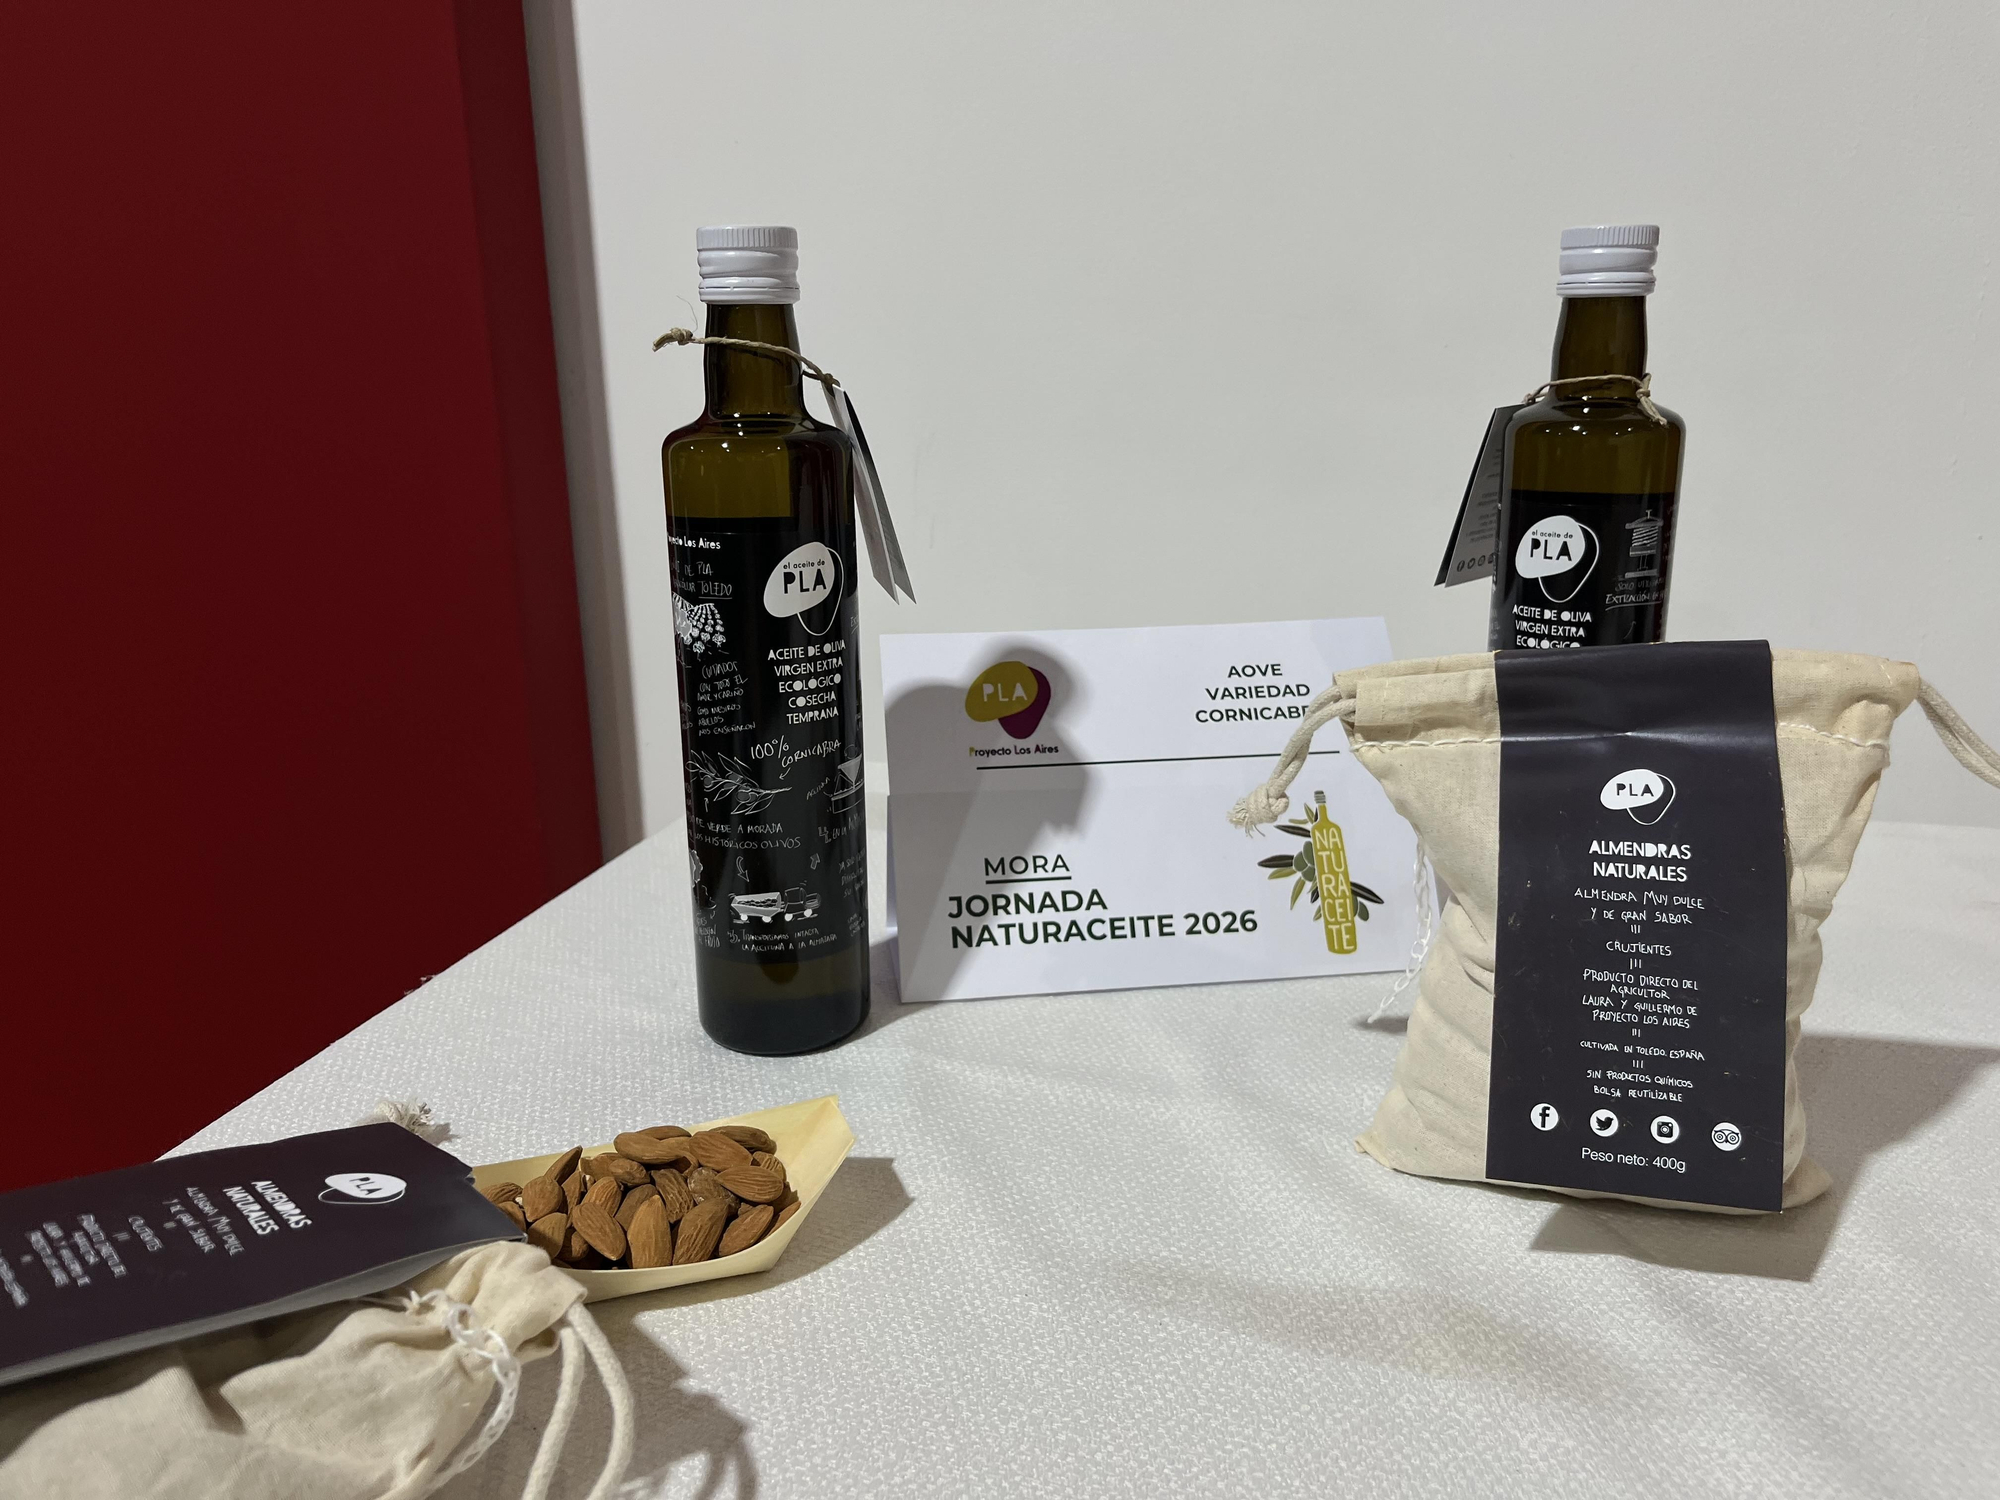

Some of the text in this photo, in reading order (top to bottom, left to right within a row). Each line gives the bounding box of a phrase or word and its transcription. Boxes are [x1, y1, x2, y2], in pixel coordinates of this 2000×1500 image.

[684, 536, 697, 548] Los
[698, 537, 721, 550] Aires
[1539, 530, 1561, 538] aceite
[1530, 538, 1572, 562] PLA
[696, 560, 714, 576] PLA
[783, 558, 826, 570] el aceite de
[697, 580, 733, 596] TOLEDO
[783, 568, 827, 594] PLA
[1512, 604, 1592, 622] ACEITE DE OLIVA
[1516, 620, 1586, 638] VIRGEN EXTRA
[768, 639, 846, 660] ACEITE DE OLIVA
[774, 656, 844, 676] VIRGEN EXTRA
[1228, 664, 1283, 678] AOVE
[779, 673, 842, 692] ECOLÓGICO
[982, 682, 1028, 702] PLA
[1205, 684, 1310, 700] VARIEDAD
[788, 690, 836, 708] COSECHA
[786, 706, 839, 724] TEMPRANA
[1195, 705, 1310, 723] CORNICAB
[750, 734, 790, 760] 100%
[782, 739, 842, 768] CORNICABRA
[969, 744, 1060, 758] Proyecto Los Aires
[1616, 782, 1654, 797] PLA
[747, 822, 784, 834] MORADA
[760, 836, 802, 850] OLIVOS
[1588, 840, 1692, 860] ALMENDRAS
[984, 854, 1070, 876] MORA
[1593, 861, 1688, 882] NATURALES
[948, 888, 1108, 919] JORNADA
[1574, 887, 1705, 910] ALMENDRA MUY DULCE
[1590, 906, 1693, 924] Y DE GRAN SABOR
[951, 910, 1258, 948] NATURACEITE 2026
[1606, 940, 1672, 956] CRUJIENTES
[1583, 968, 1698, 990] PRODUCTO DIRECTO DEL
[1610, 984, 1670, 1000] AGRICULTOR
[1582, 994, 1698, 1016] LAURA Y GUILLERMO DE
[1592, 1010, 1690, 1028] PROYECTO LOS AIRES
[1580, 1040, 1619, 1052] CULTIVADA
[1624, 1045, 1633, 1054] EN
[1669, 1050, 1706, 1061] ESPAÑA
[1586, 1069, 1694, 1089] SIN PRODUCTOS QUÍMICOS
[1593, 1084, 1683, 1102] BOLSA REUTILIZABLE
[1582, 1148, 1686, 1174] Peso neto: 400g
[349, 1176, 382, 1196] PLA
[222, 1186, 280, 1236] NATURALES
[252, 1180, 313, 1229] ALMENDRAS
